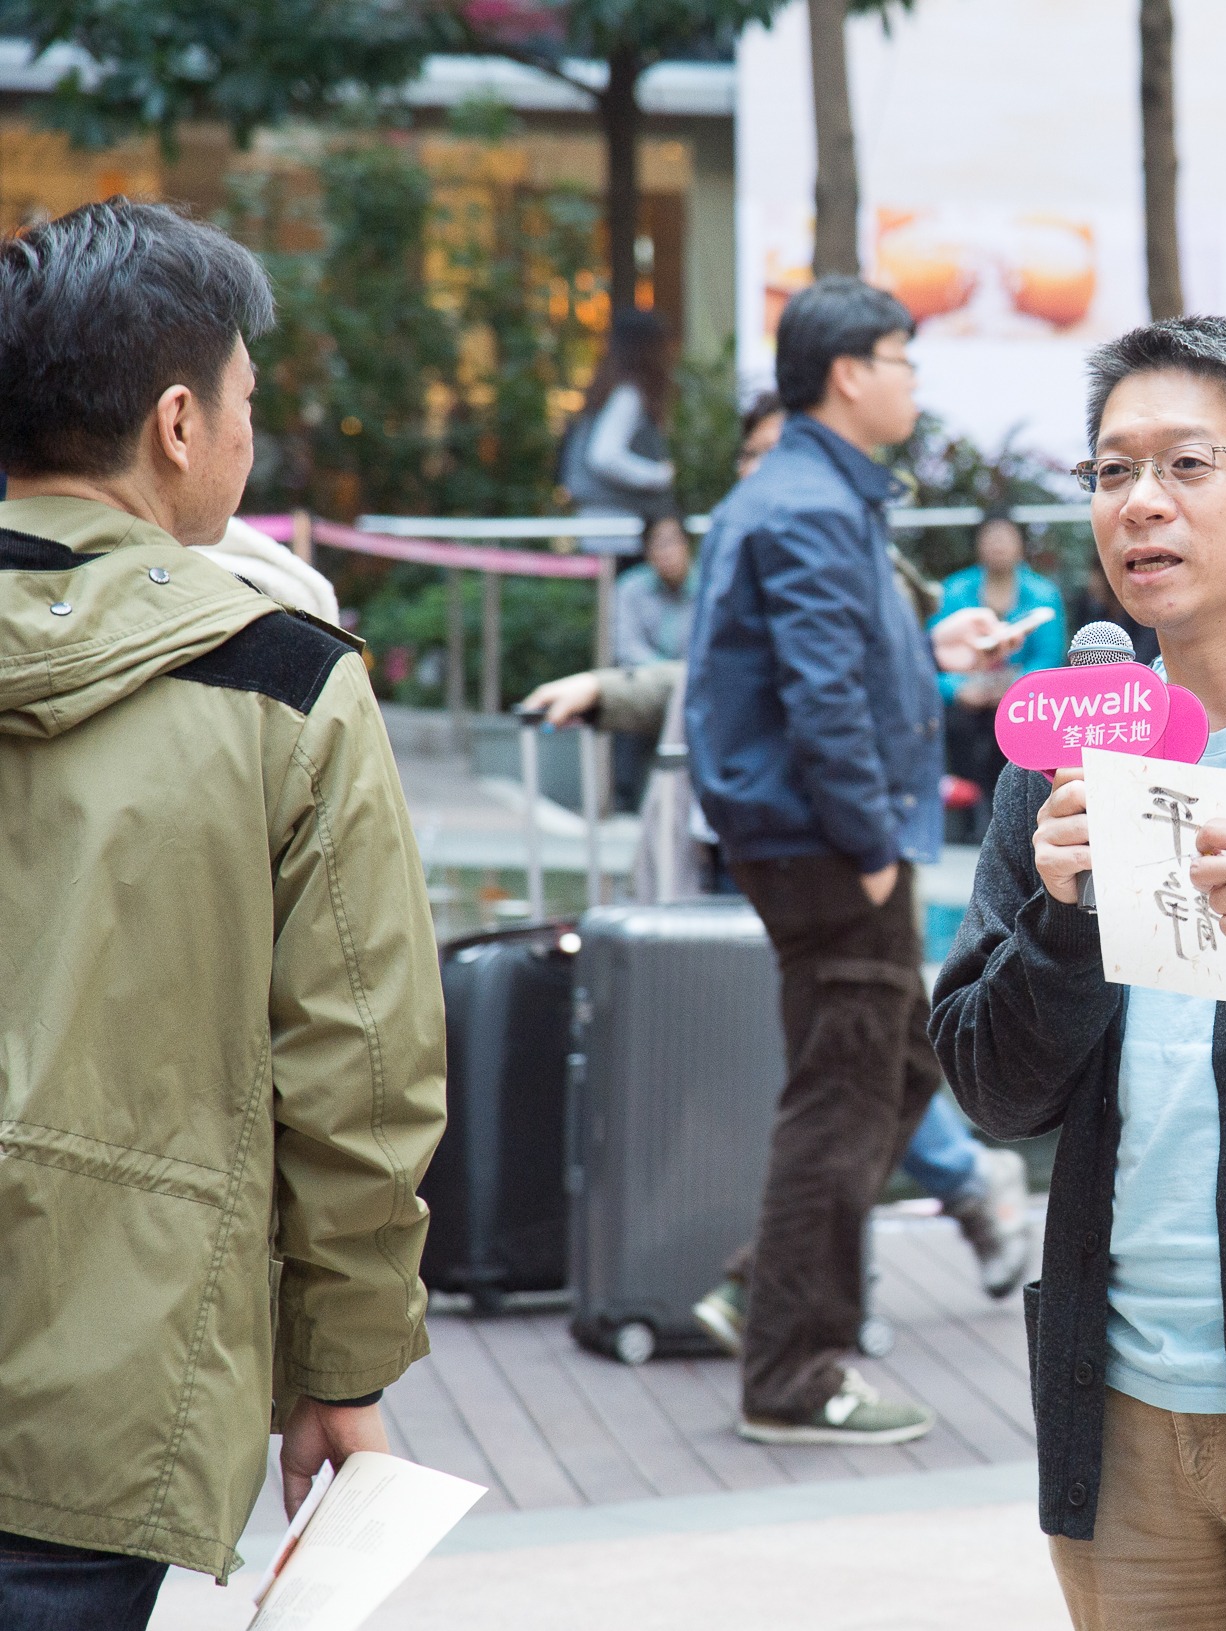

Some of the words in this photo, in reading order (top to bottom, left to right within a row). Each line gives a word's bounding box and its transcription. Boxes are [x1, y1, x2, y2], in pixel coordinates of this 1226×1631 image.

[1008, 681, 1152, 731] citywalk
[1062, 719, 1151, 748] 荃新天地
